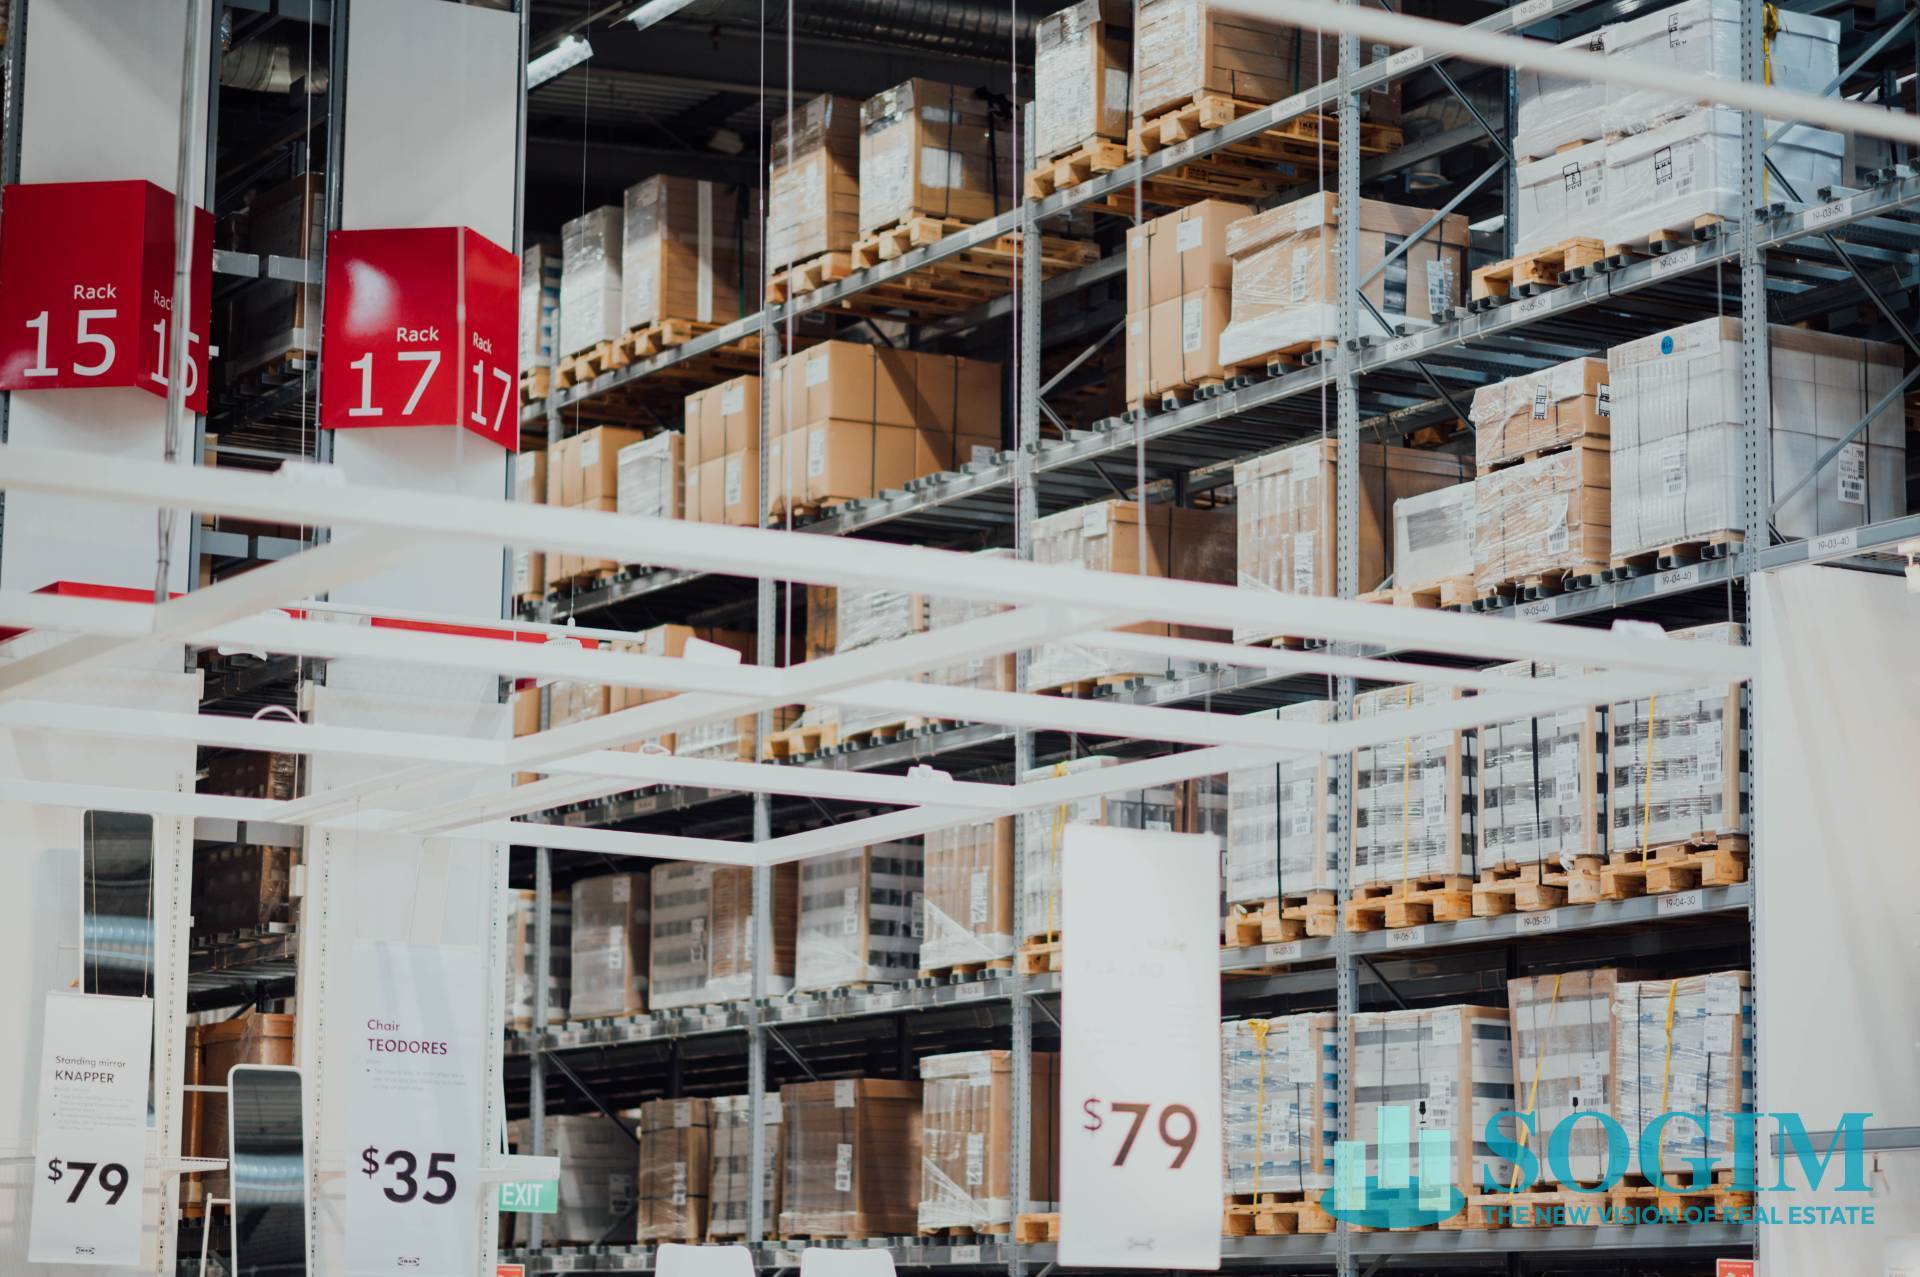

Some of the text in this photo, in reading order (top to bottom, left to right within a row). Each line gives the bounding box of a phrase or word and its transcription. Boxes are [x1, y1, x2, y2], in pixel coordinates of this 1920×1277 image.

[73, 283, 117, 300] Rack
[153, 289, 173, 311] Rac
[24, 309, 118, 377] 15
[396, 326, 439, 342] Rack
[472, 332, 492, 355] Rack
[348, 351, 441, 417] 17
[471, 359, 512, 432] 17
[1817, 535, 1850, 551] 19-03-40
[1666, 895, 1696, 909] 19-04-30
[367, 1018, 400, 1031] Chair
[367, 1038, 448, 1055] TEODORES
[56, 1055, 126, 1068] Standing mirror
[55, 1070, 115, 1084] KNAPPER
[1083, 1096, 1198, 1171] $79
[48, 1157, 129, 1205] $79
[361, 1145, 457, 1205] $35
[502, 1182, 543, 1206] EXIT
